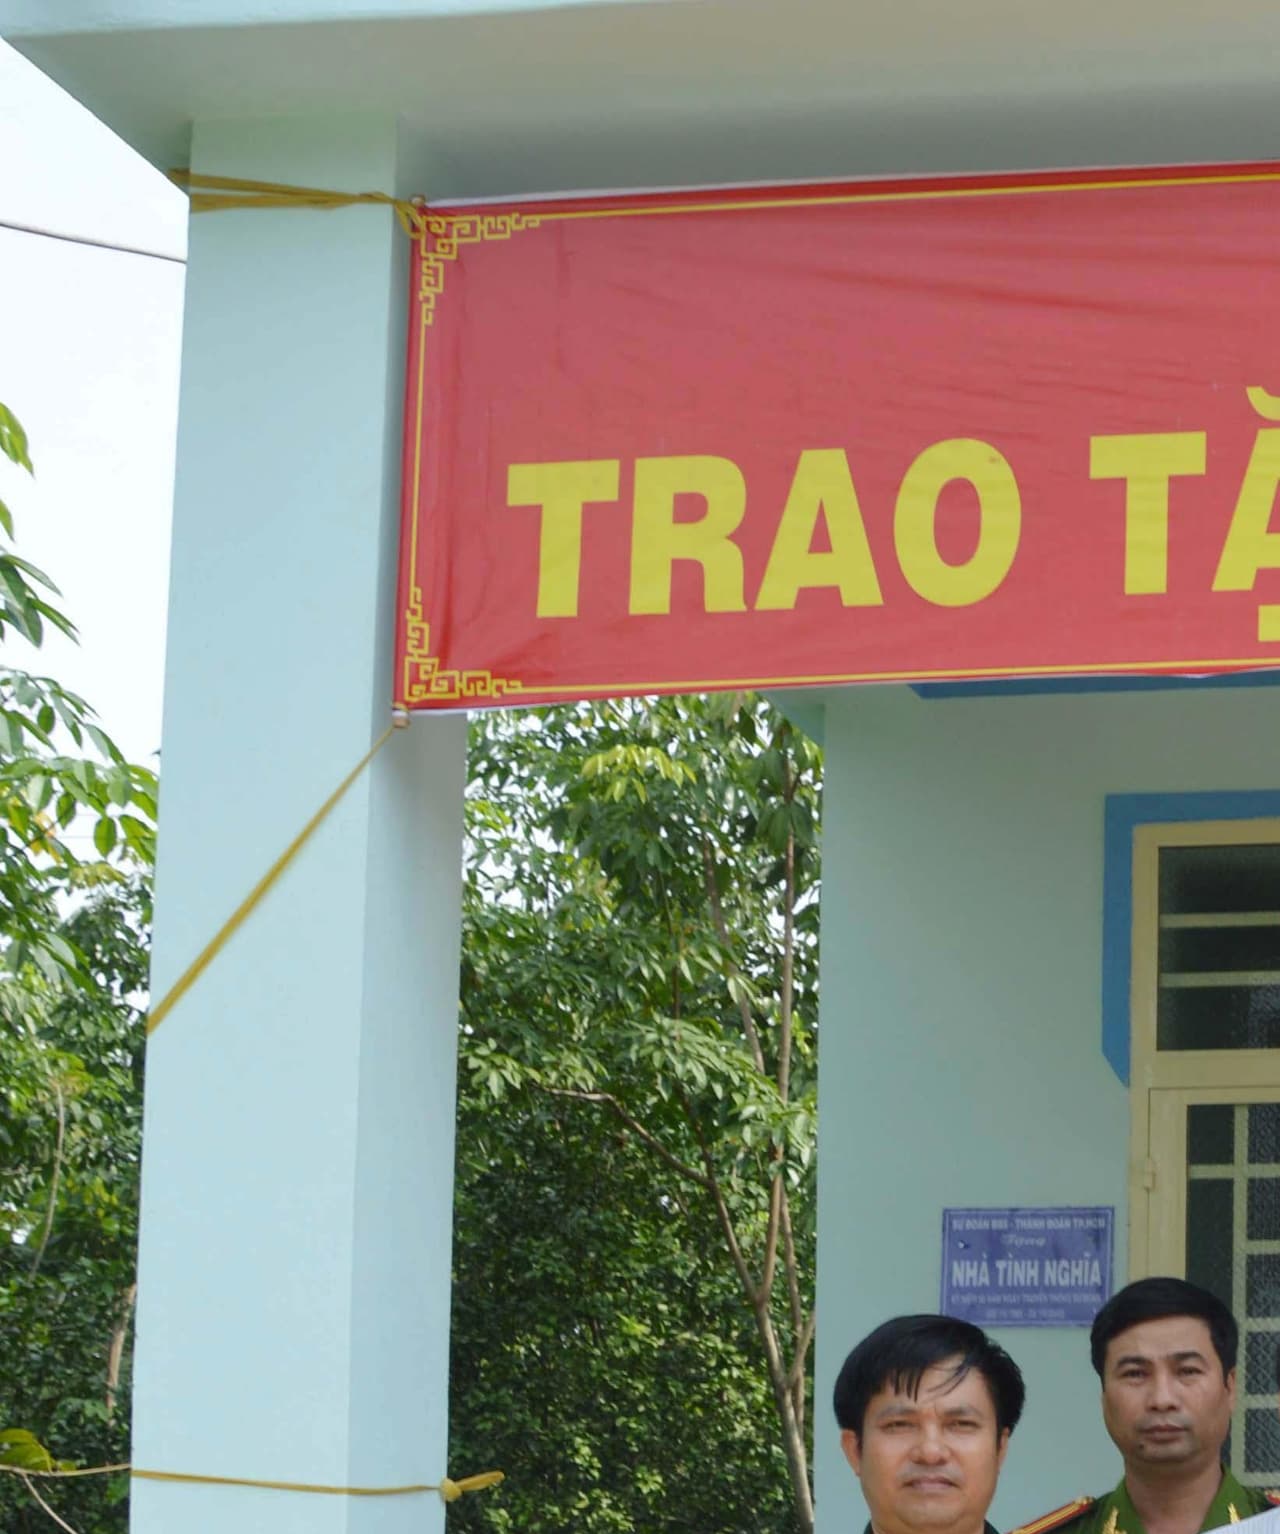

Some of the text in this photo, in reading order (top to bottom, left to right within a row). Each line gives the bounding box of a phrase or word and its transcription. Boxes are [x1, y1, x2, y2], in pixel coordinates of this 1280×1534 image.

[505, 436, 1023, 620] TRAO
[952, 1251, 1102, 1287] NHÀ TÌNH NGHĨA
